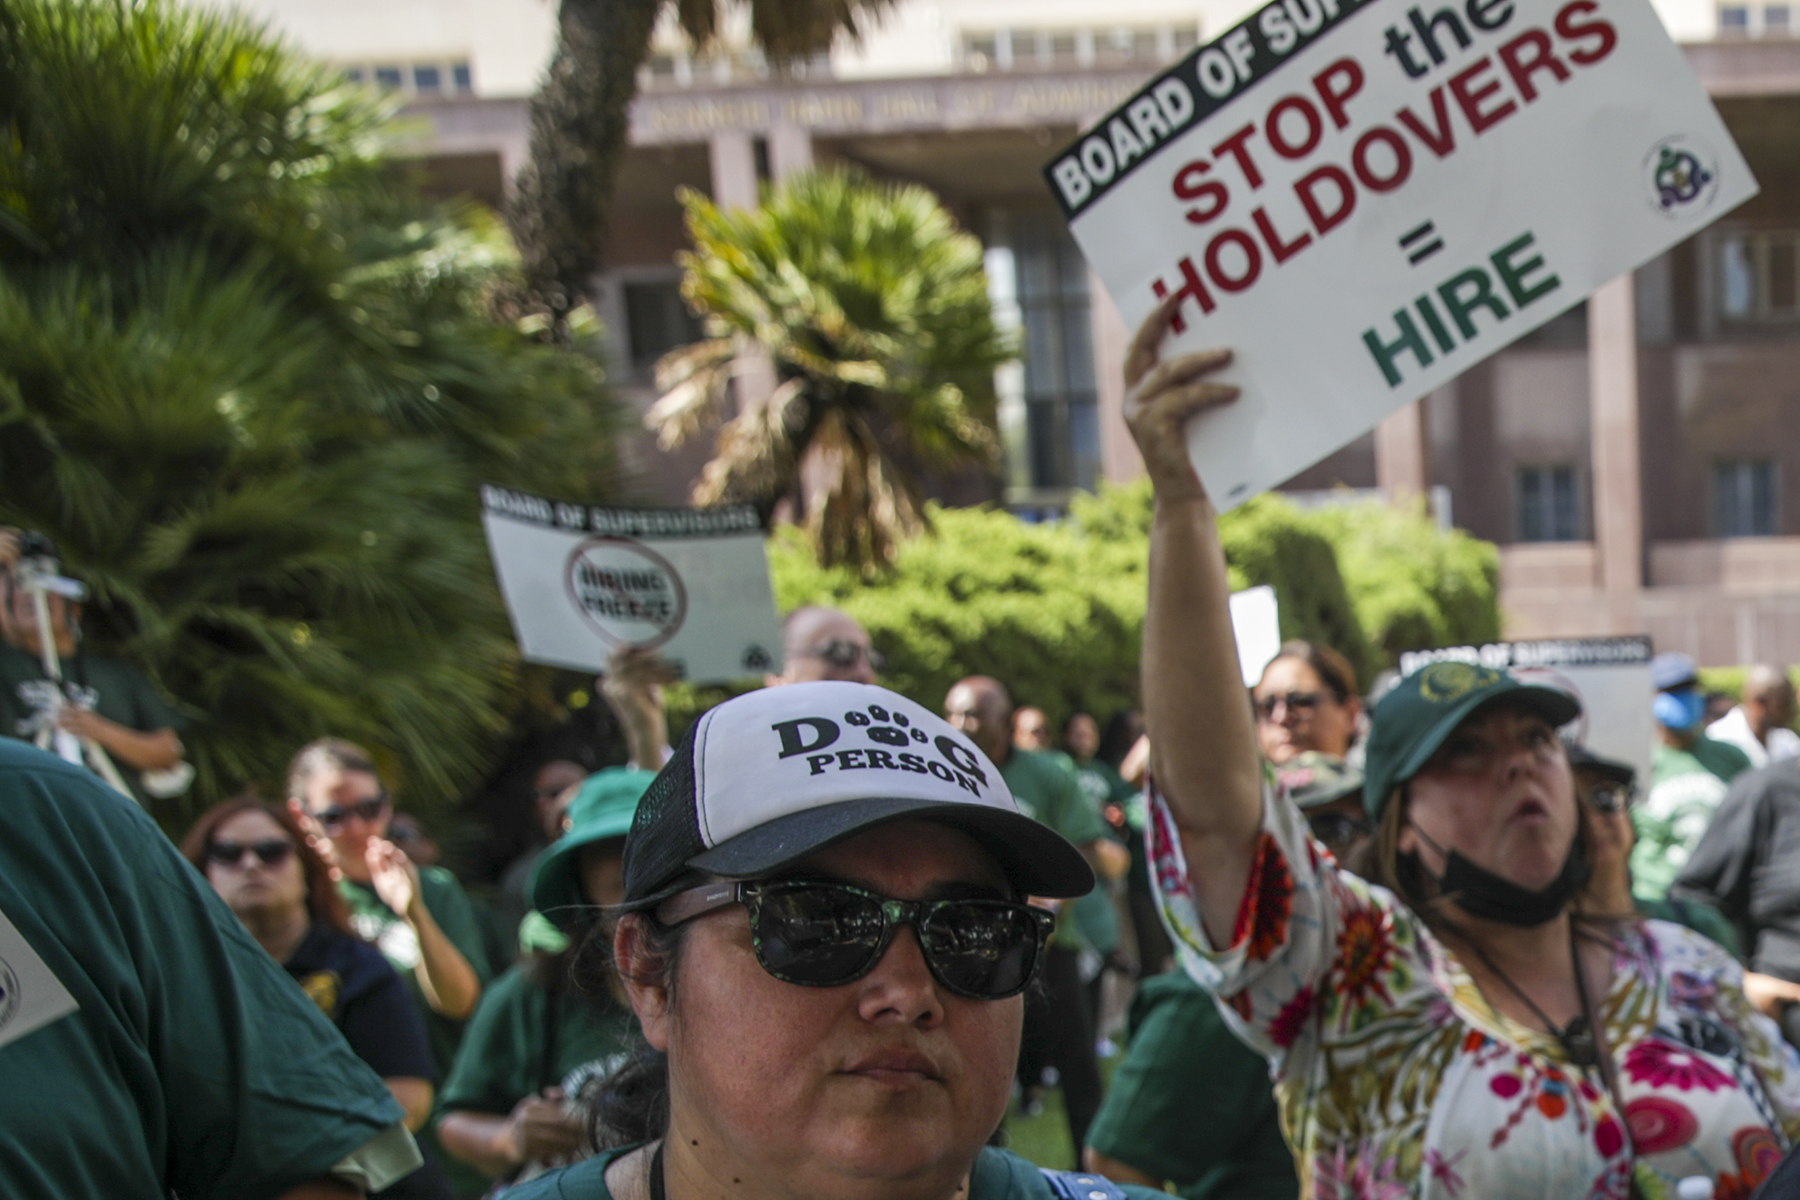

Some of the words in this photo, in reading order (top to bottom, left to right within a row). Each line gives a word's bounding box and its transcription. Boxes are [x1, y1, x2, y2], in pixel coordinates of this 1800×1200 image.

[1052, 77, 1195, 210] BOARD
[1196, 27, 1255, 98] OF
[1153, 0, 1619, 335] HOLDOVERS
[1172, 57, 1366, 226] STOP
[1384, 0, 1516, 79] the
[1362, 230, 1562, 389] HIRE
[483, 484, 554, 524] BOARD
[556, 503, 587, 529] OF
[590, 503, 762, 536] SUPERVISORS
[806, 748, 982, 799] PERSON
